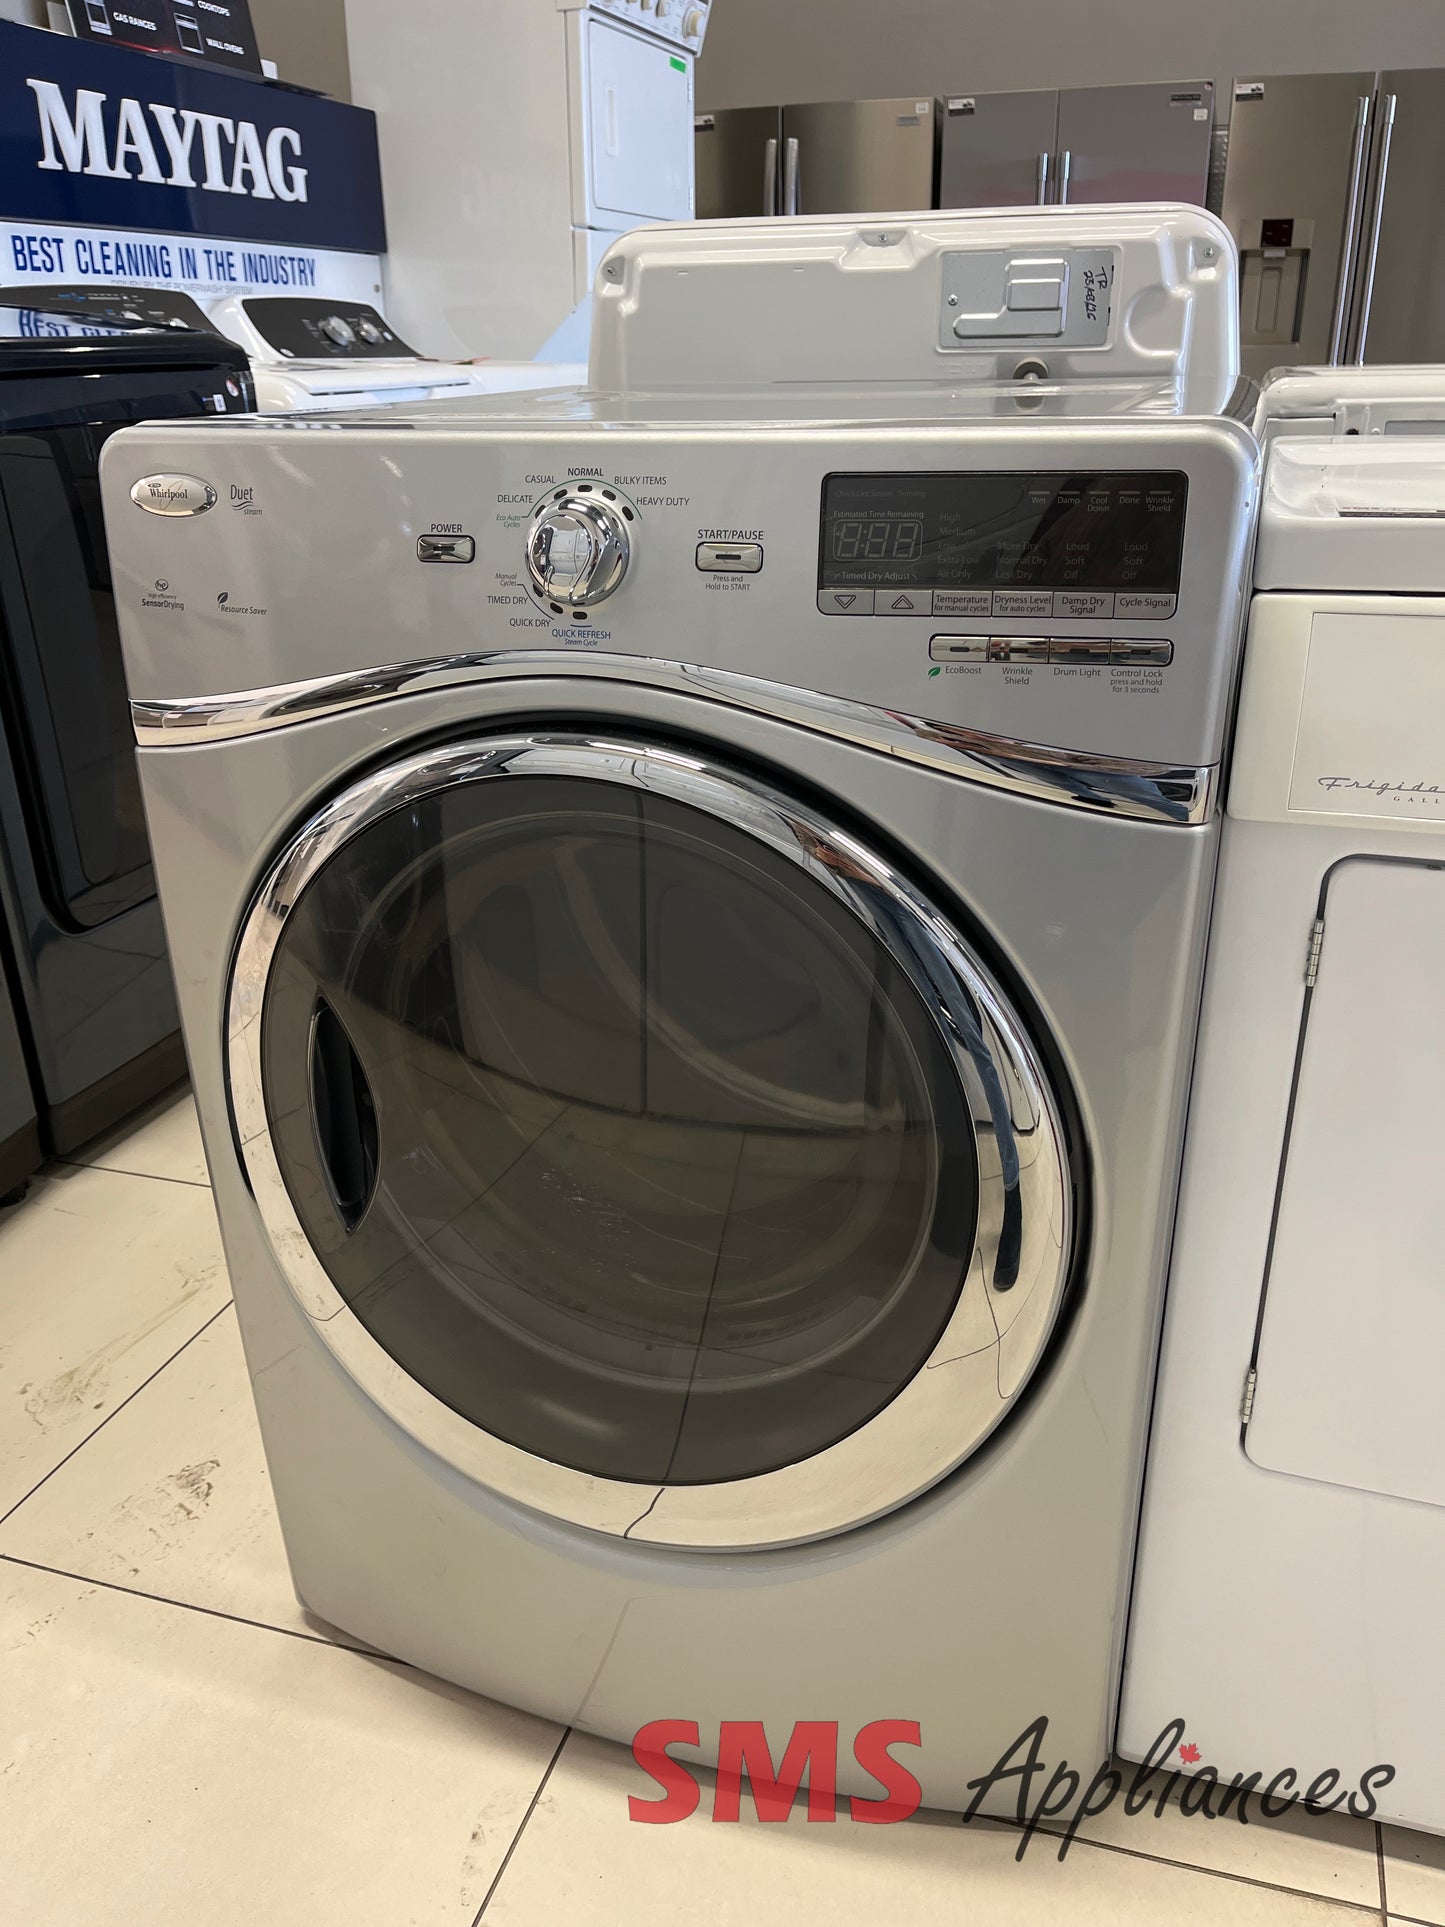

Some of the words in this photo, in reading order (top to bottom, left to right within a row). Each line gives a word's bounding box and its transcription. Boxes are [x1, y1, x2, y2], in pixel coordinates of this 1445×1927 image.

[113, 12, 129, 24] GAS
[130, 16, 157, 30] RANGES
[206, 38, 224, 49] WALL
[26, 78, 308, 203] MAYTAG
[11, 235, 64, 273] BEST
[74, 239, 172, 278] CLEANING
[179, 246, 198, 280] IN
[203, 249, 236, 282] THE
[242, 252, 316, 286] INDUSTRY
[568, 468, 604, 477] NORMAL
[525, 475, 555, 484] CASUAL
[614, 476, 640, 485] BULKY
[642, 476, 667, 485] ITEMS
[150, 488, 188, 501] Whirlpool
[230, 484, 254, 500] Duet
[498, 495, 534, 504] DELICATE
[636, 497, 664, 506] HEAVY
[666, 498, 690, 506] DUTY
[1058, 497, 1080, 505] Damp
[887, 511, 924, 519] Remaining
[940, 514, 960, 522] High
[431, 524, 463, 533] POWER
[697, 529, 764, 541] START/PAUSE
[1066, 542, 1089, 550] Loud
[1124, 542, 1148, 551] Loud
[1032, 557, 1048, 566] Dry
[1065, 557, 1085, 565] Soft
[1124, 557, 1143, 565] Soft
[713, 575, 729, 583] Press
[730, 575, 743, 583] and
[842, 571, 866, 580] Timed
[868, 572, 882, 581] Dry
[885, 572, 910, 581] Adjust
[1016, 571, 1032, 580] Dry
[1064, 571, 1079, 579] Off
[705, 583, 720, 591] Hold
[142, 599, 185, 611] SensorDrying
[487, 596, 511, 604] TIMED
[513, 597, 528, 605] DRY
[936, 596, 988, 606] Temperature
[994, 596, 1027, 606] Dryness
[1029, 596, 1051, 604] Level
[1062, 597, 1088, 608] Damp
[1090, 597, 1106, 608] Dry
[1119, 598, 1144, 608] Cycle
[1146, 598, 1171, 608] Signal
[221, 605, 248, 614] Resource
[250, 606, 267, 615] Saver
[969, 605, 989, 613] cycles
[1026, 605, 1046, 613] cycles
[1069, 606, 1095, 615] Signal
[510, 618, 534, 627] QUICK
[535, 619, 551, 627] DRY
[552, 629, 576, 638] QUICK
[578, 630, 611, 639] REFRESH
[945, 666, 982, 675] EcoBoost
[1002, 667, 1032, 676] Wrinkle
[1054, 668, 1078, 676] Drum
[1080, 668, 1100, 678] Light
[1111, 669, 1141, 677] Control
[1144, 669, 1163, 678] Lock
[1004, 676, 1029, 685] Shield
[1110, 679, 1128, 687] press
[1130, 678, 1144, 686] and
[1146, 678, 1163, 686] hold
[1130, 686, 1159, 694] seconds
